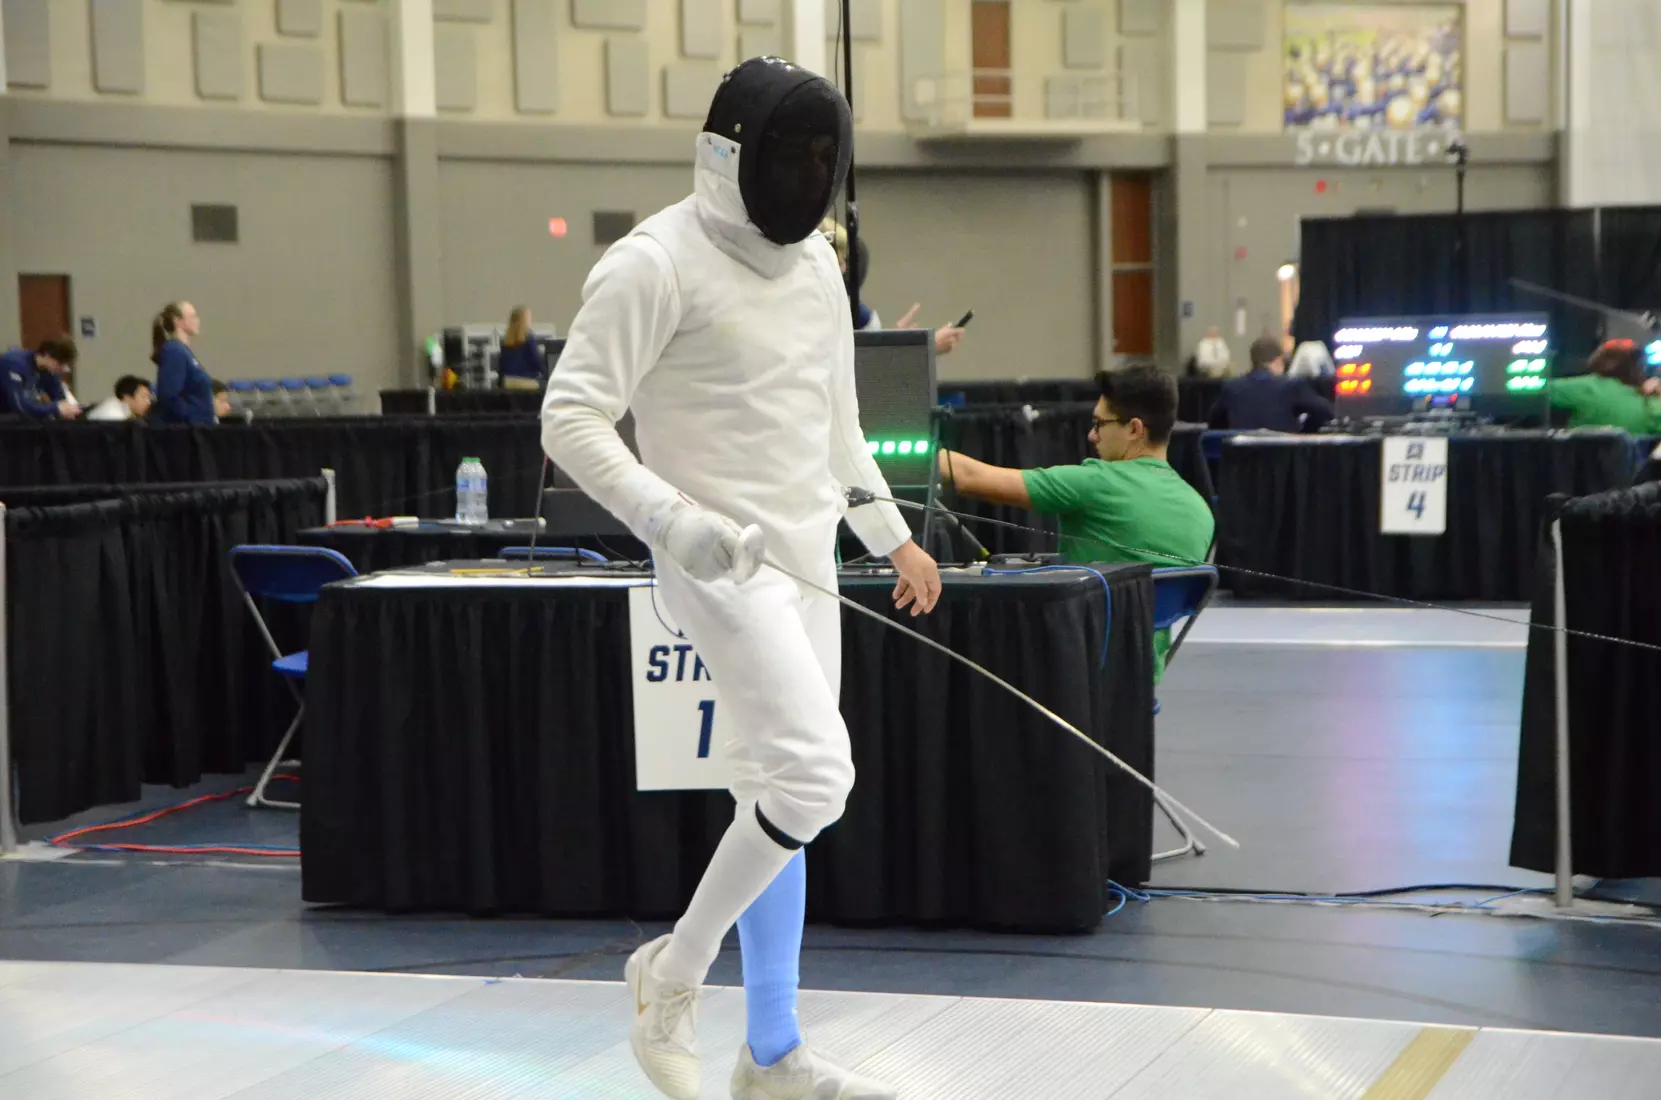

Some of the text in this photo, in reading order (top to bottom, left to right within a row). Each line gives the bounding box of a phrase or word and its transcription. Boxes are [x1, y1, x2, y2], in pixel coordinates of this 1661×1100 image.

[1388, 463, 1448, 483] STRIP
[1406, 491, 1426, 519] 4
[696, 700, 716, 758] 1
